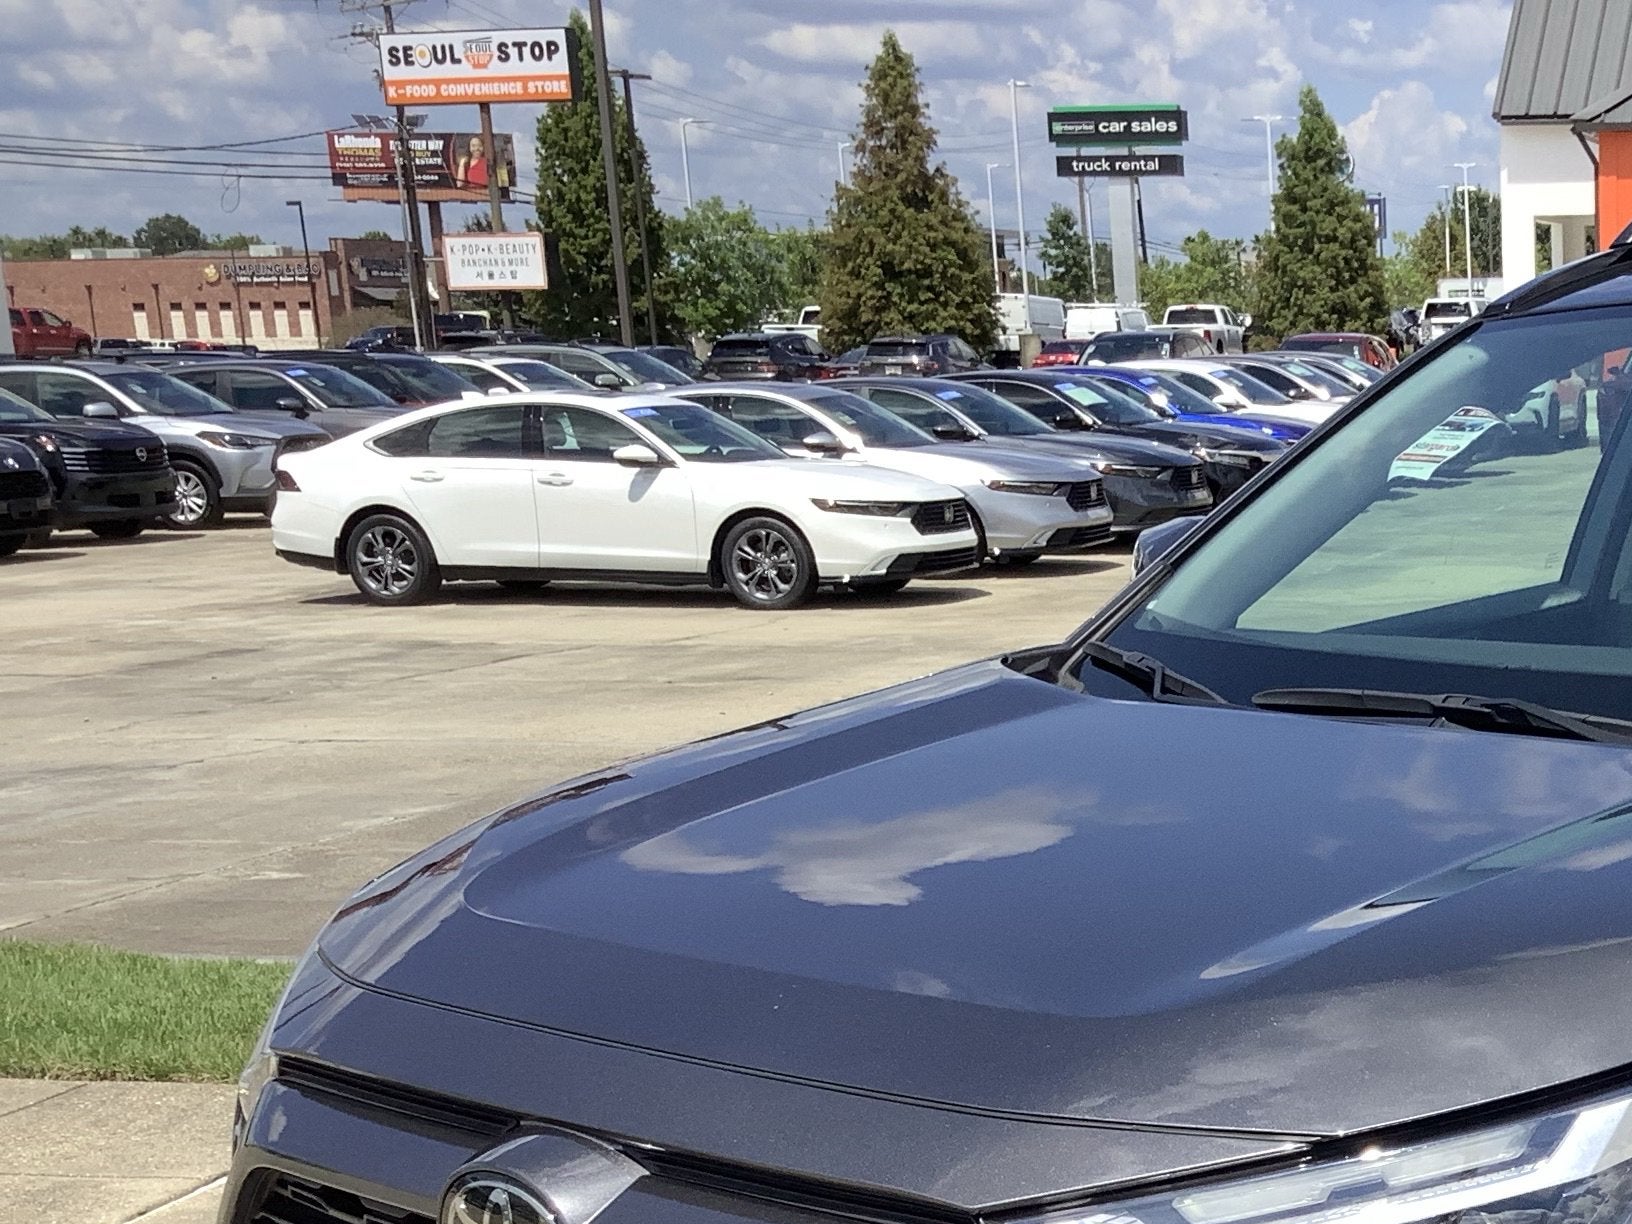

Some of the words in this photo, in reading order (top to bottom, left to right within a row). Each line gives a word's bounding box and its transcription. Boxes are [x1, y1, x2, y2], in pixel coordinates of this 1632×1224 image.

[388, 44, 462, 68] SEOUL
[497, 40, 560, 63] STOP
[388, 84, 437, 98] K-FOOD
[440, 81, 523, 96] CONVENIENCE
[528, 80, 568, 94] STORE
[1098, 121, 1127, 133] car
[1131, 117, 1178, 133] sales
[337, 148, 381, 156] THOMAS
[1072, 158, 1111, 172] truck
[1115, 157, 1159, 171] rental
[222, 263, 282, 276] DUMPLING
[461, 258, 499, 268] BANCHAN
[508, 257, 530, 267] MORE
